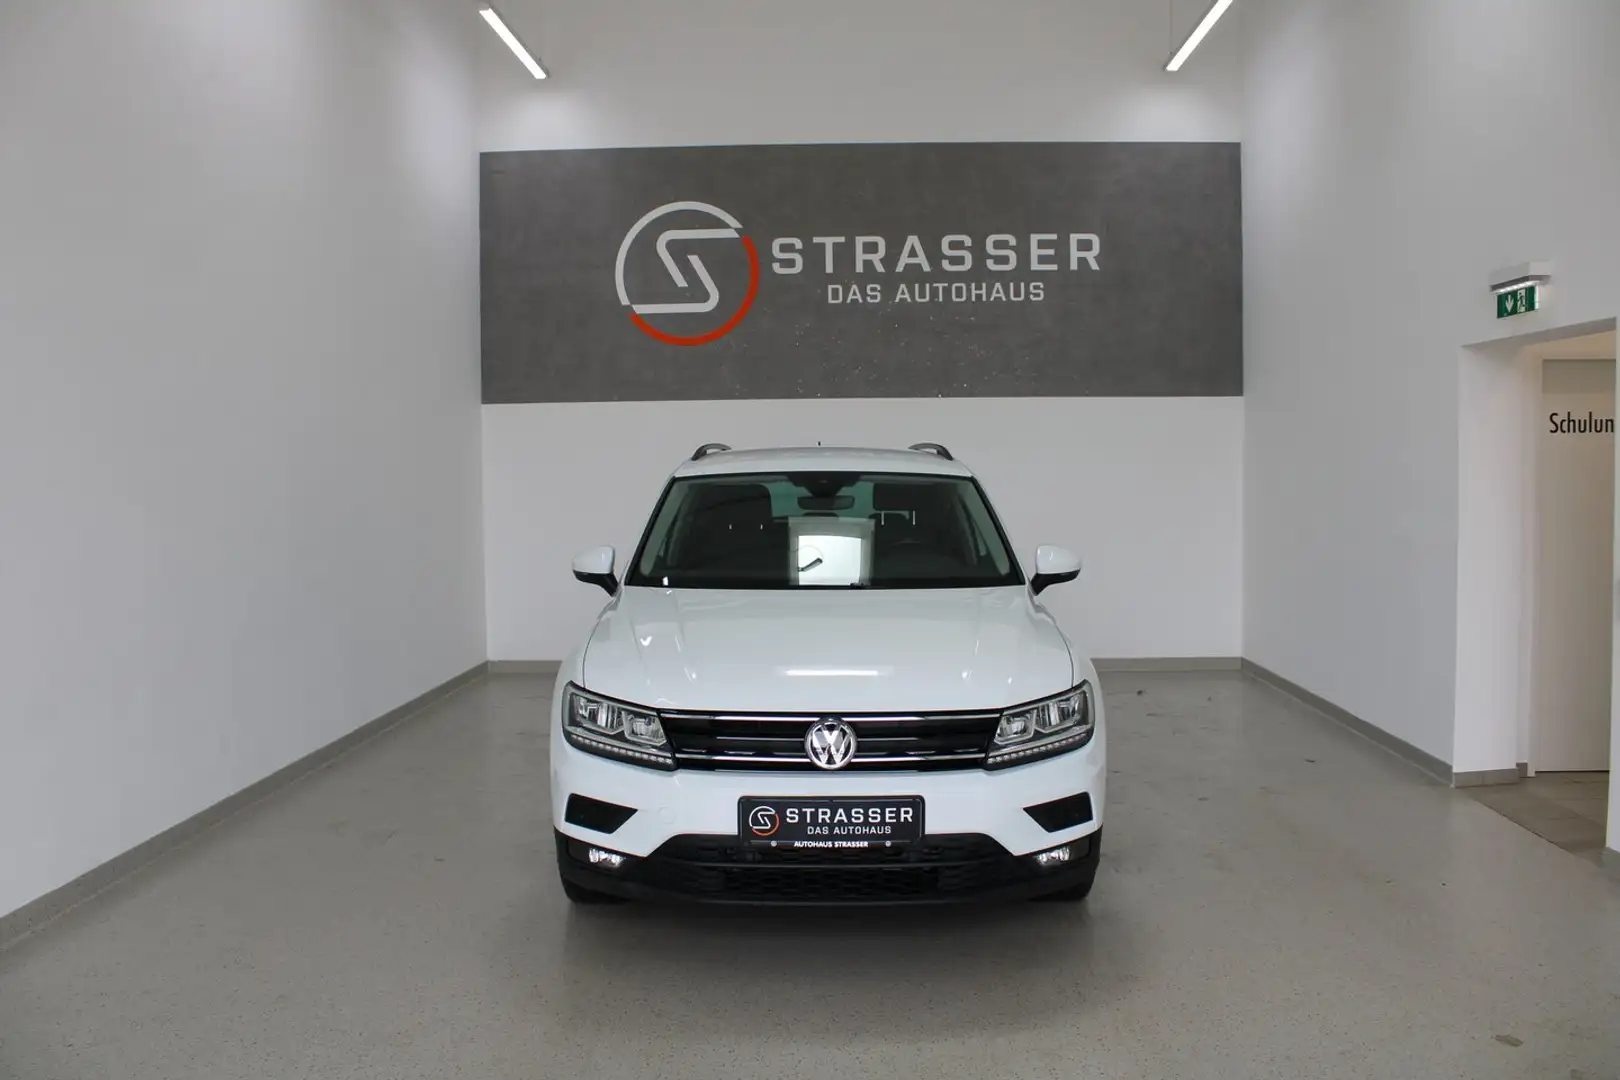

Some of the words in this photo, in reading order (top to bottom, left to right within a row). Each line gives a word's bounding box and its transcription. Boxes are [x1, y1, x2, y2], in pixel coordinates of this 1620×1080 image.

[771, 233, 1101, 274] STRASSER
[827, 284, 882, 303] DAS
[895, 282, 1046, 303] AUTOHAUS
[1549, 411, 1614, 433] Schulun
[786, 807, 913, 823] STRASSER
[807, 826, 828, 835] DAS
[833, 825, 892, 834] AUTOHAUS
[793, 840, 833, 848] AUTOHAUS
[834, 840, 869, 848] STRASSER
